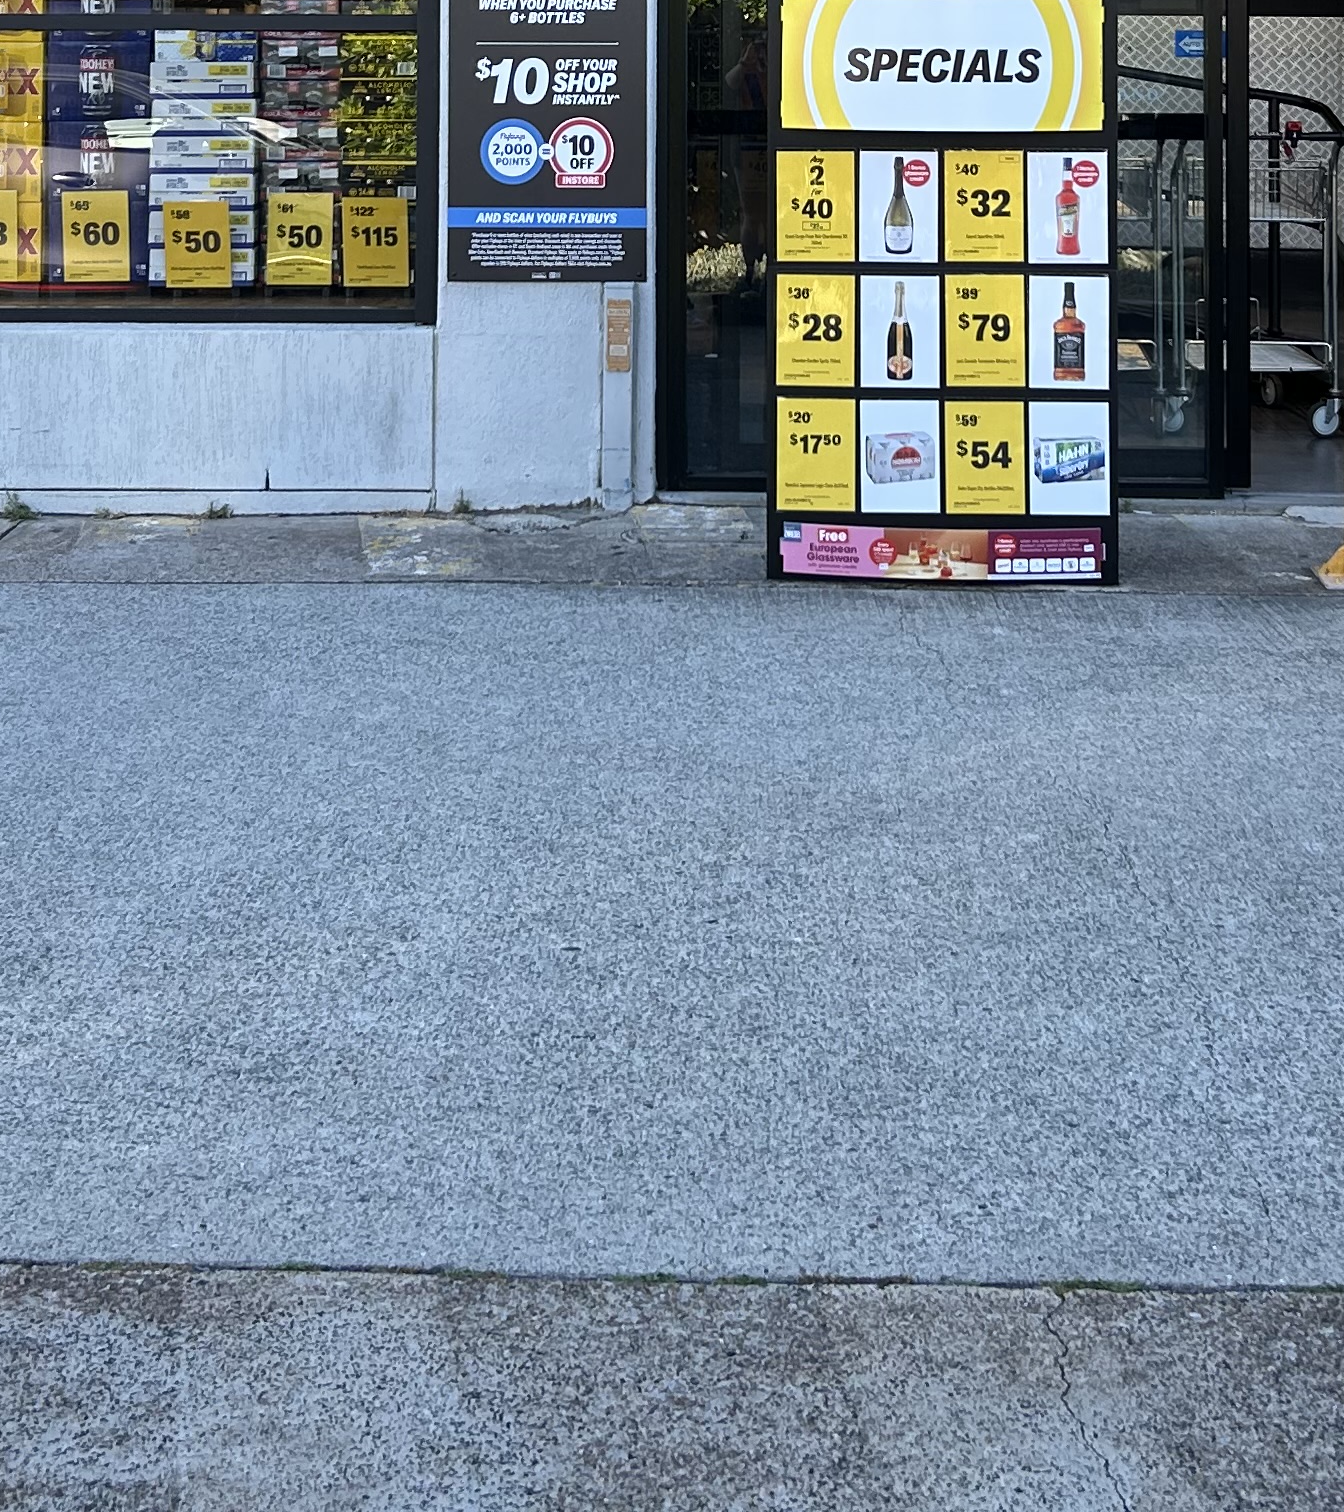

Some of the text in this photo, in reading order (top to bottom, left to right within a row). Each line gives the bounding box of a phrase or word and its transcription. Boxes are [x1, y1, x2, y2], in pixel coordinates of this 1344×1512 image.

[510, 12, 585, 24] 6+ BOTTLES
[555, 59, 618, 71] OFF YOUR
[844, 47, 1042, 84] SPECIALS
[79, 72, 114, 93] NEW
[475, 56, 550, 105] $10
[552, 72, 617, 93] SHOP
[492, 143, 532, 156] 2,000
[561, 135, 595, 156] $10
[81, 152, 114, 173] NEW
[496, 158, 530, 166] POINTS
[570, 158, 595, 169] OFF
[810, 155, 825, 165] Any
[955, 162, 980, 177] $40
[562, 176, 600, 185] INSTORE
[810, 166, 825, 186] 2
[791, 198, 833, 219] $40
[956, 188, 1011, 218] $32
[476, 212, 618, 224] AND SCAN YOUR FLYBUYS
[71, 221, 120, 246] $60
[172, 230, 221, 253] $50
[277, 224, 322, 248] $50
[351, 226, 398, 246] $115
[788, 313, 843, 342] $28
[958, 313, 1011, 342] $79
[788, 411, 813, 424] $20
[957, 440, 1012, 469] $54
[1058, 443, 1089, 464] HAHN
[819, 530, 848, 542] Free
[807, 552, 859, 563] Glassware
[810, 543, 857, 554] European
